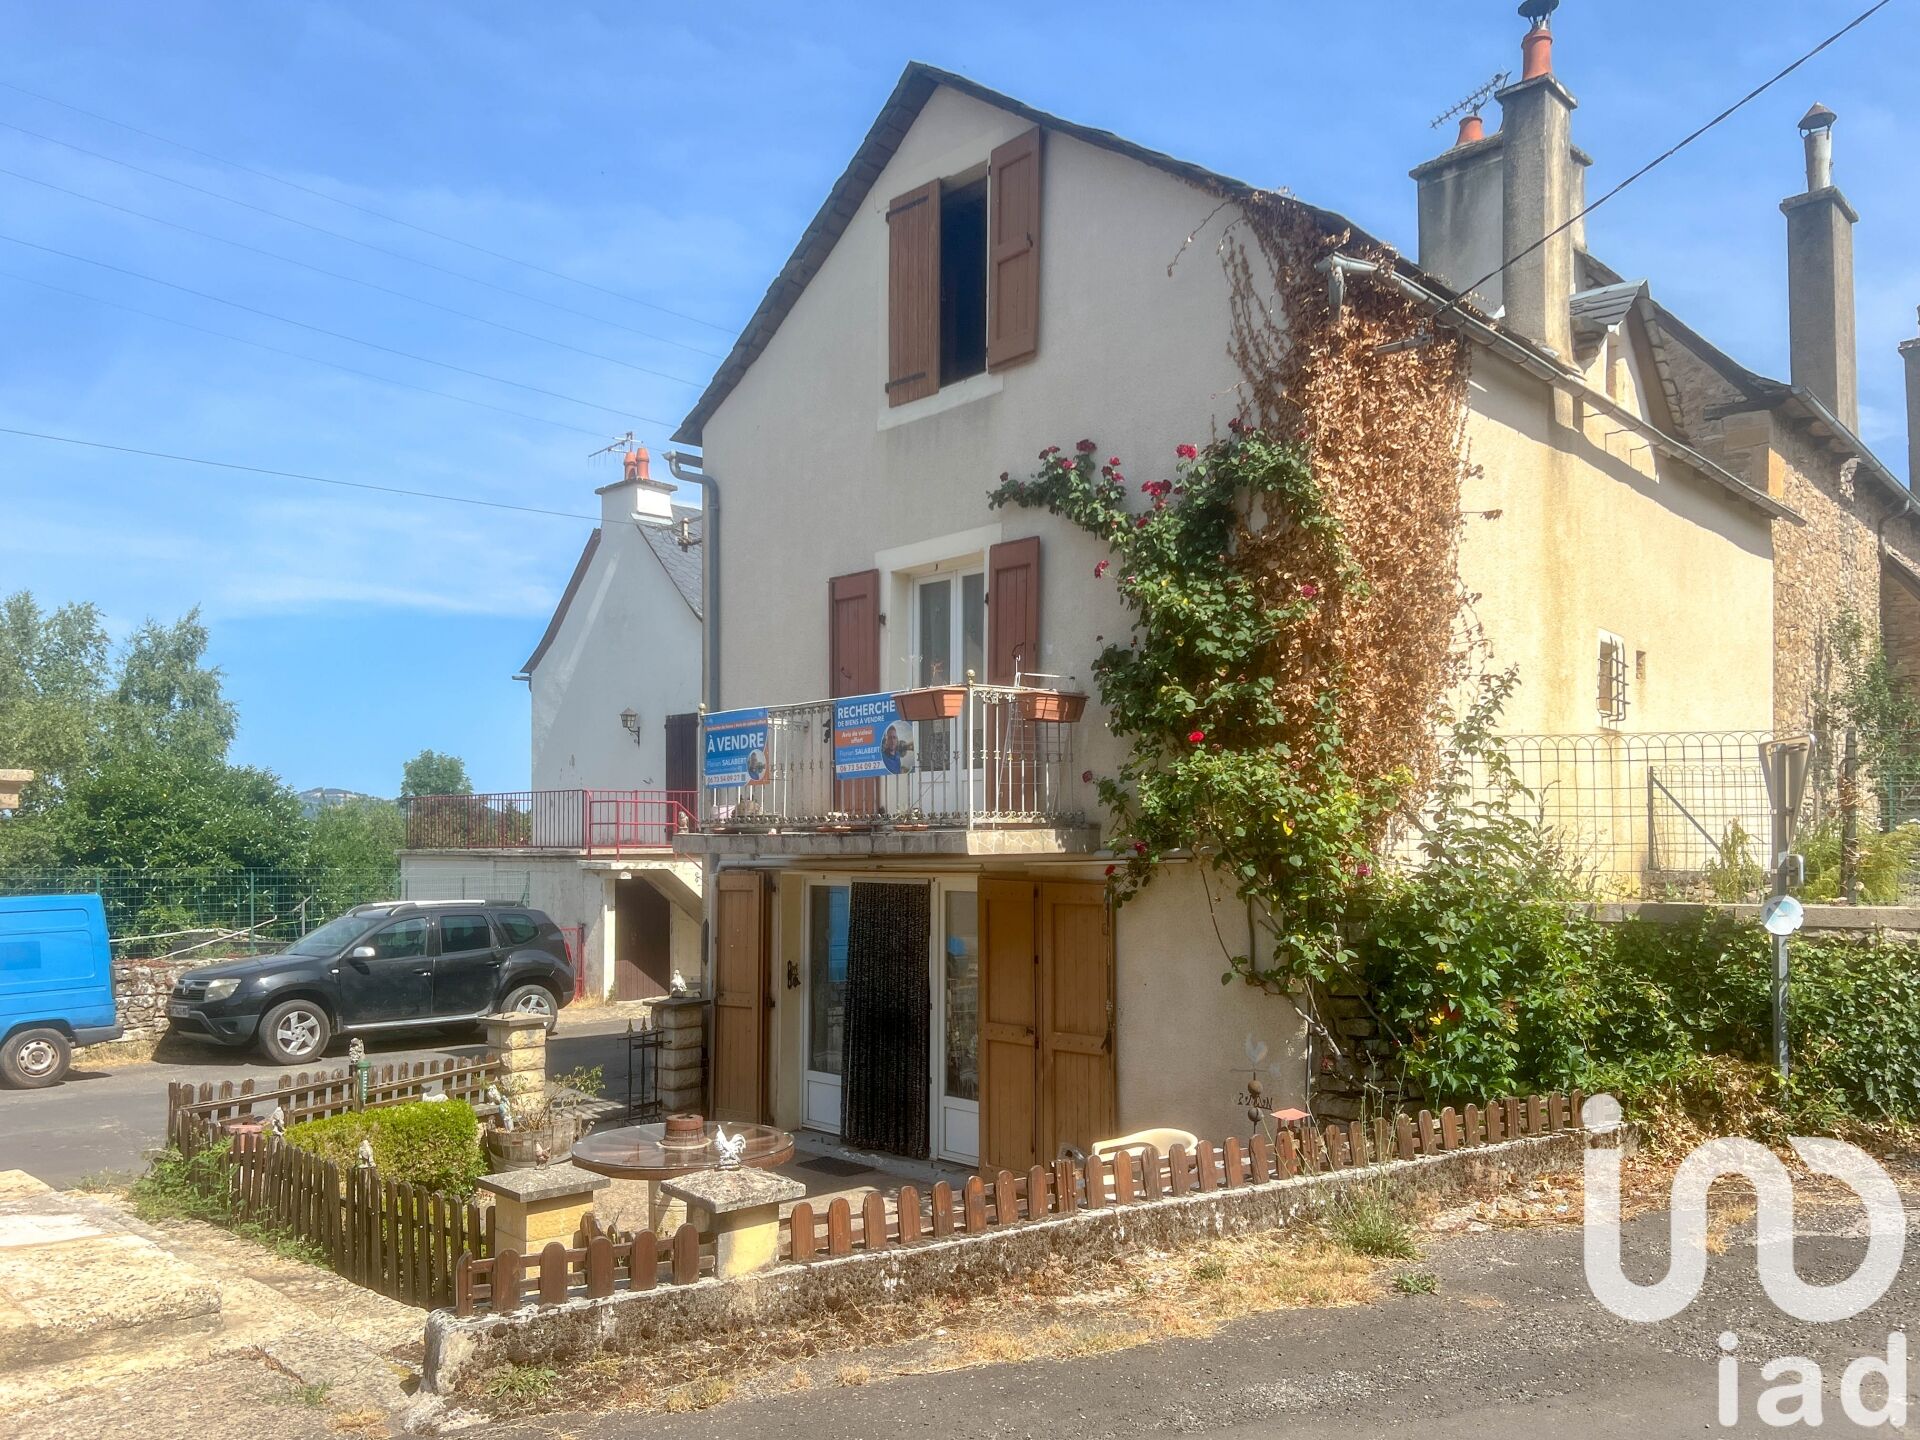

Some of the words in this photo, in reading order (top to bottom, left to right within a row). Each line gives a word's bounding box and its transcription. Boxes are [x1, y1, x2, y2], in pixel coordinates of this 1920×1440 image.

[838, 700, 896, 719] RECHERCHE
[845, 719, 859, 727] BIENS
[864, 715, 885, 724] VENDRE
[707, 734, 716, 753] À
[717, 732, 765, 752] VENDRE
[855, 746, 880, 755] SALABERT
[722, 757, 747, 767] SALABERT
